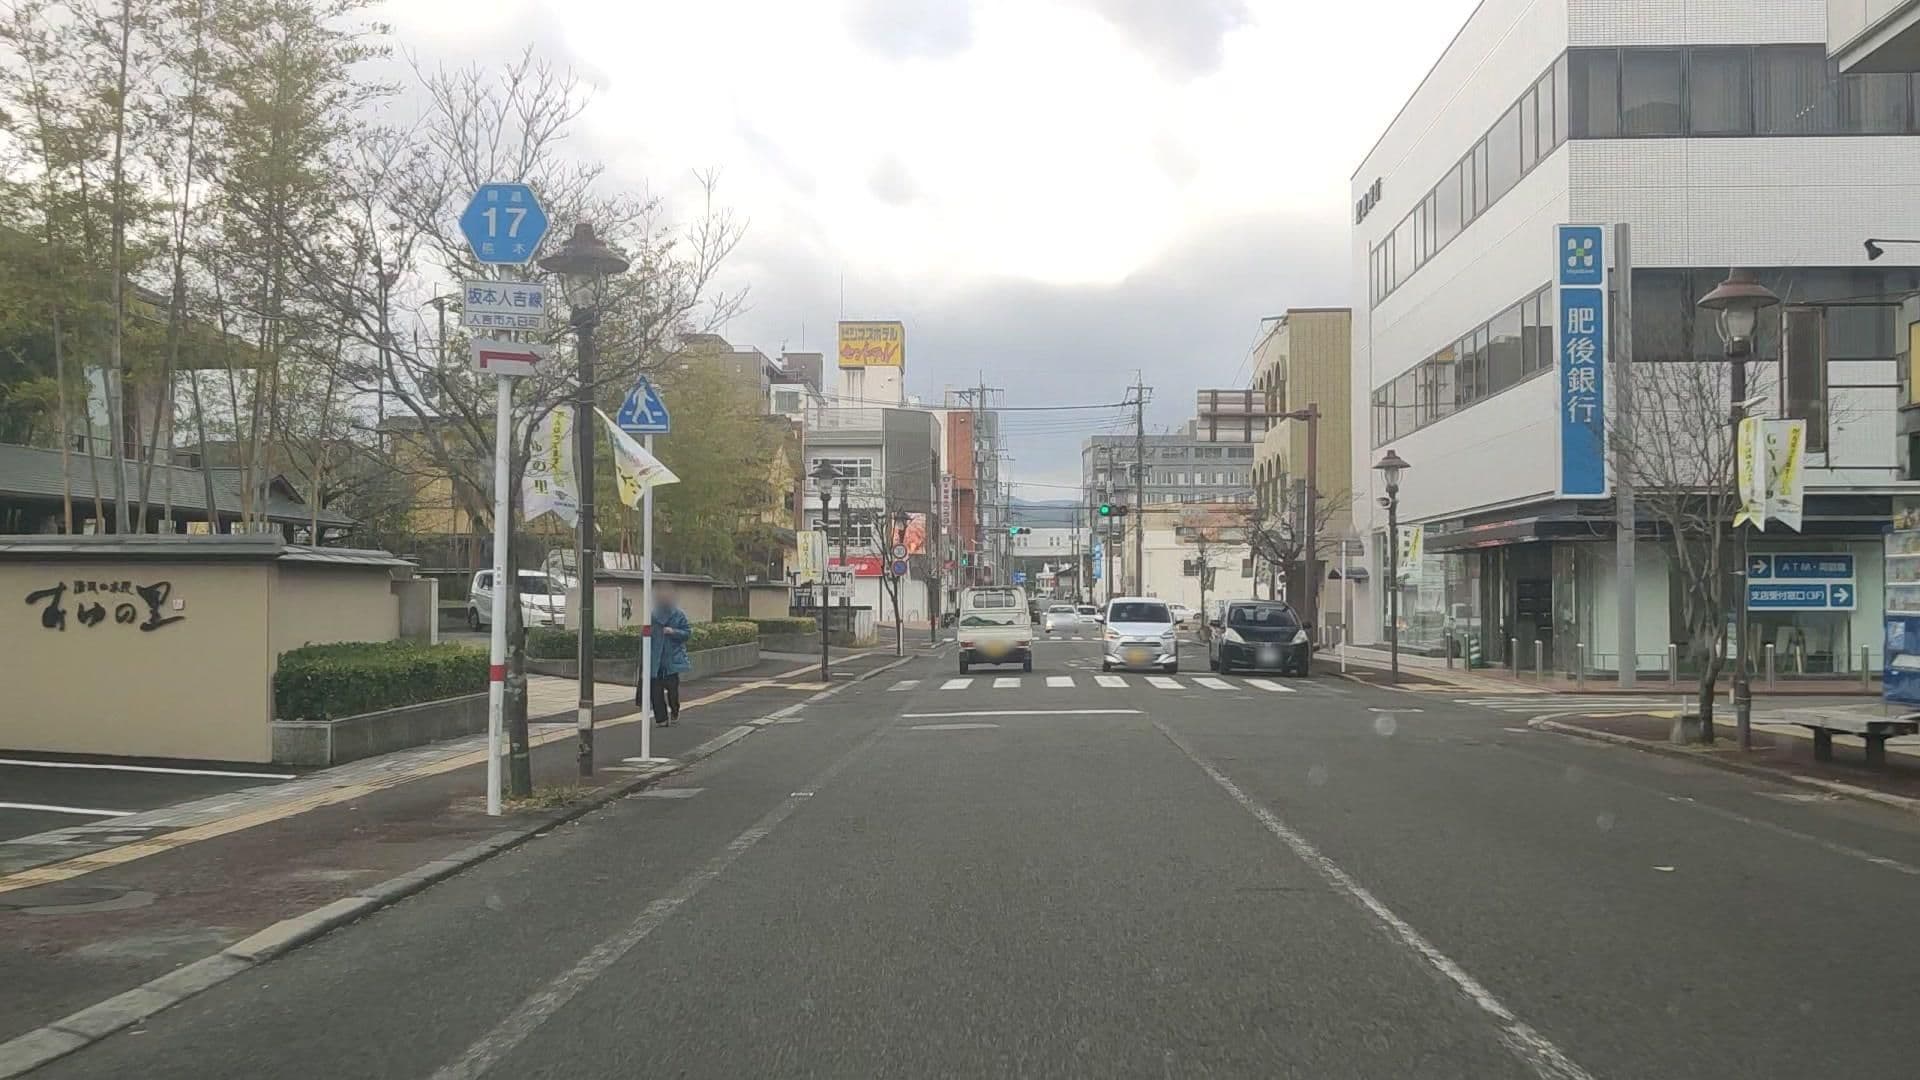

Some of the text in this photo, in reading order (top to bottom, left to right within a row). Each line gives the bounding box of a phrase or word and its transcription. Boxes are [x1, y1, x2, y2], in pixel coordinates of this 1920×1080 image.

[481, 207, 528, 238] 17
[468, 287, 543, 308] 坂本人吉線
[1567, 307, 1597, 424] 肥後銀行
